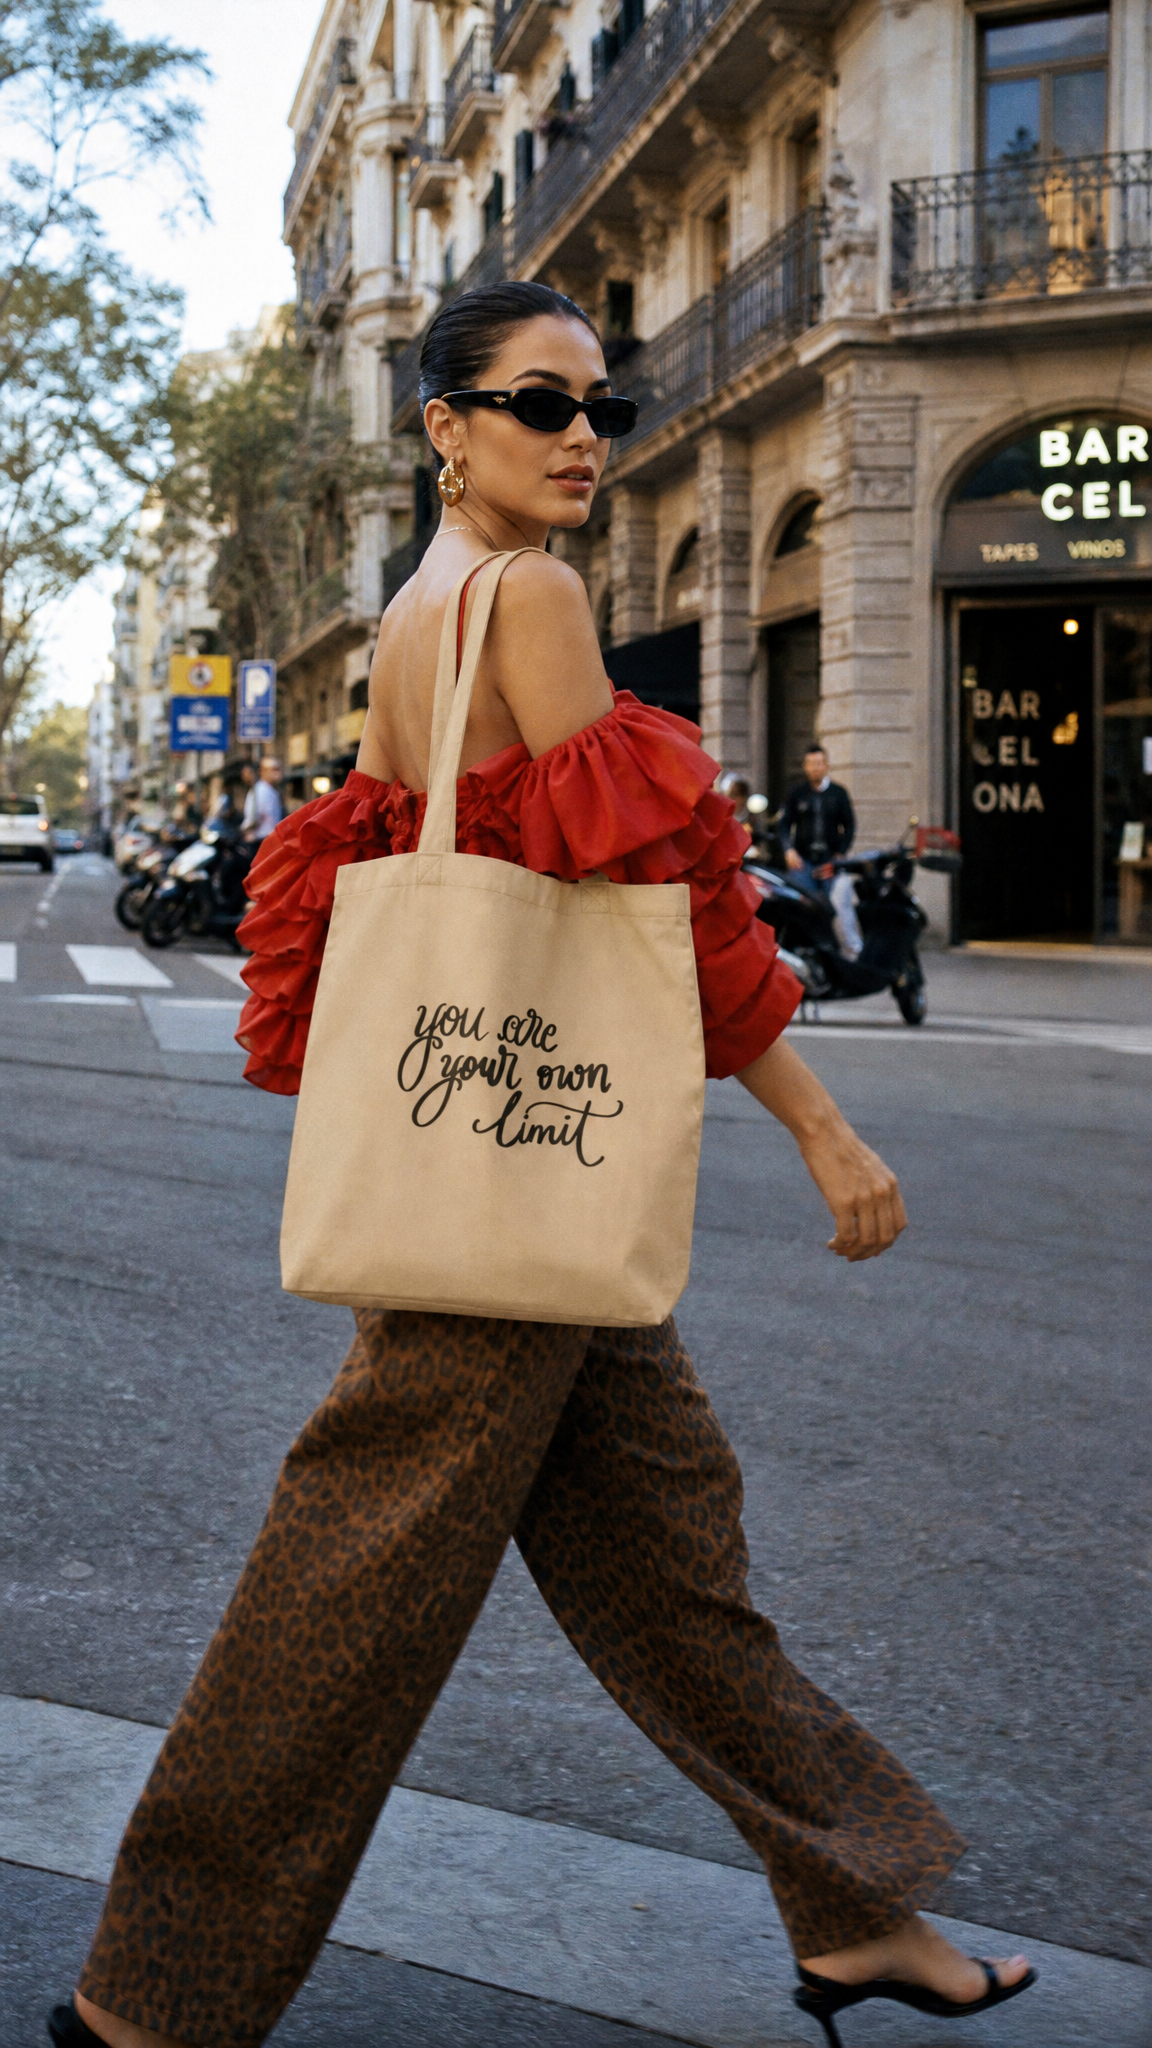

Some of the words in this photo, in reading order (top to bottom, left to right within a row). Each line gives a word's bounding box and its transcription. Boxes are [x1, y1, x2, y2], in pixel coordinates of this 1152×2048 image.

[1040, 424, 1149, 468] BAR
[1040, 480, 1147, 521] CEL
[979, 542, 1039, 563] TAPES
[1067, 538, 1126, 559] VINOS
[244, 666, 270, 709] P
[972, 688, 1040, 719] BAR
[972, 781, 1045, 813] ONA
[397, 1003, 489, 1092] you
[497, 1008, 558, 1053] are
[411, 1044, 522, 1128] your
[537, 1063, 611, 1093] own
[472, 1090, 624, 1167] limit
